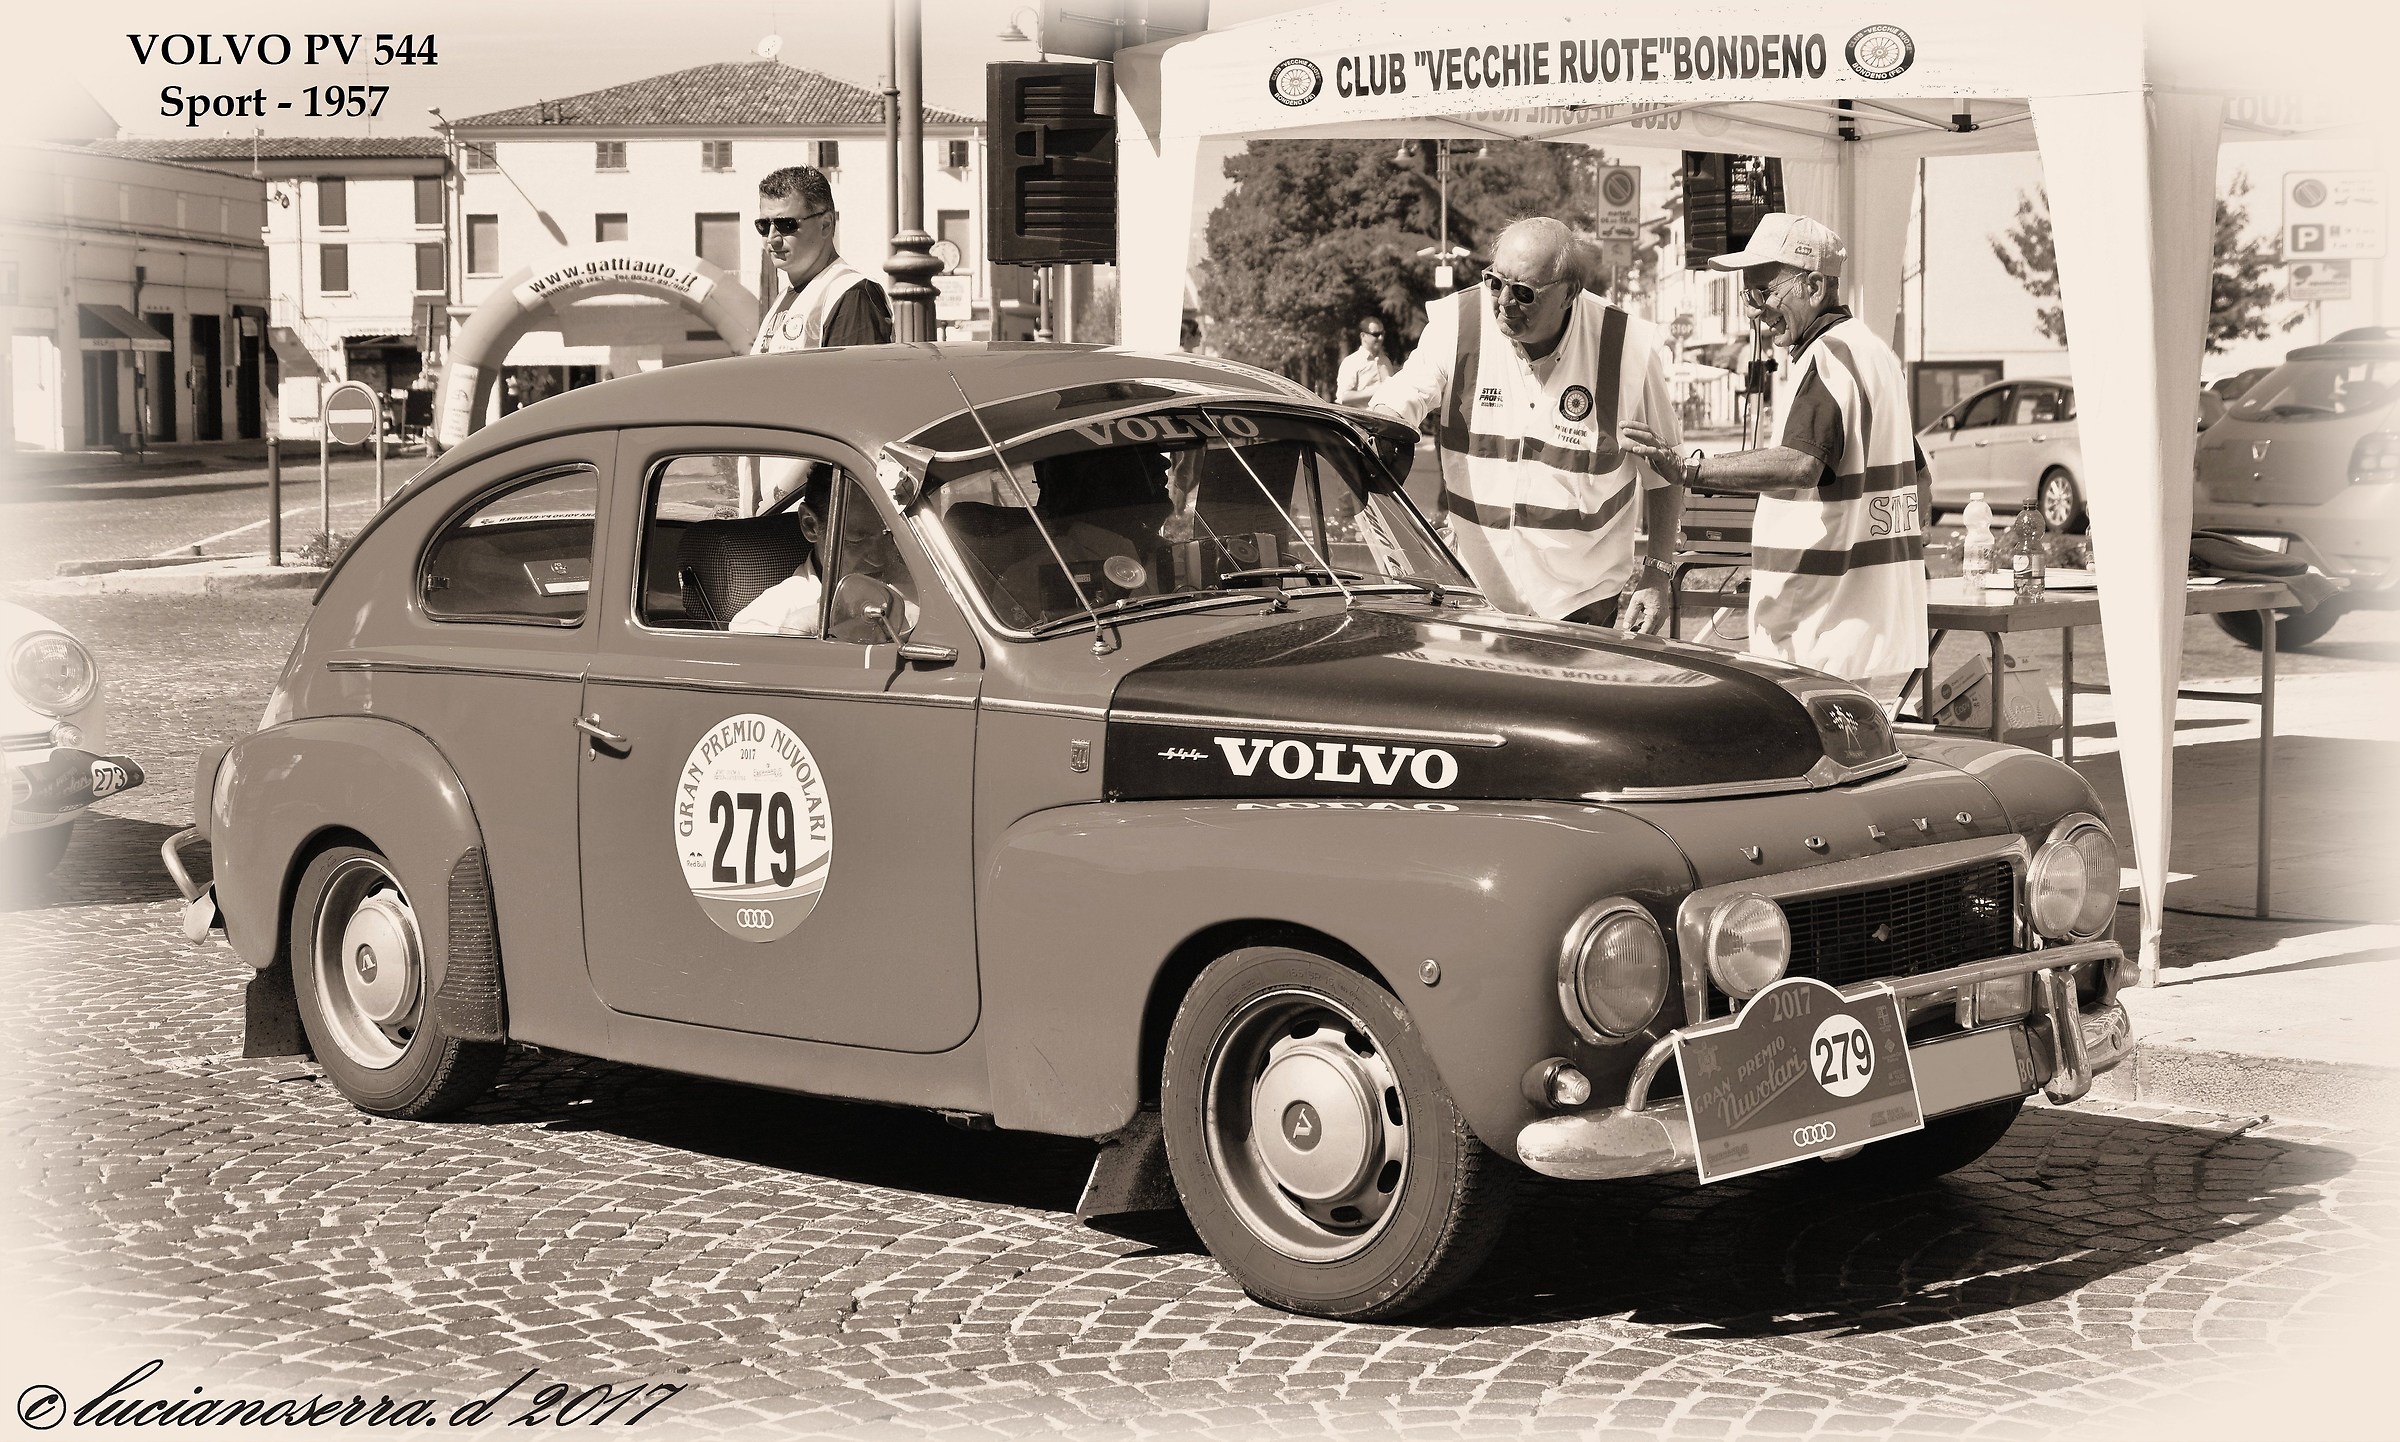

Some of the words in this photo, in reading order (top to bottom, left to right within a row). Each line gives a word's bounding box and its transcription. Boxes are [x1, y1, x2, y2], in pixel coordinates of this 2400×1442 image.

[1336, 53, 1406, 98] CLUB
[1414, 42, 1549, 91] "VECCHIE
[1852, 62, 1888, 79] BONDENO
[530, 258, 698, 292] www.gattiauto.it
[1671, 323, 1693, 335] STOP
[1074, 414, 1260, 446] VOLVO
[740, 749, 756, 760] 2017
[1158, 747, 1209, 761] 544
[1213, 737, 1459, 790] VOLVO
[93, 767, 126, 792] 273
[680, 763, 704, 837] GRAN
[701, 720, 766, 765] PREMIO
[770, 729, 826, 841] NUVOLARI
[709, 790, 797, 888] 279
[1740, 811, 1973, 862] VOLVO
[1769, 985, 1811, 1023] 2017
[1694, 1077, 1732, 1114] GRAN
[1737, 1036, 1785, 1083] PREMIO
[1815, 1028, 1873, 1086] 279
[2017, 1057, 2036, 1083] BO
[1717, 1047, 1809, 1130] Nuvolari
